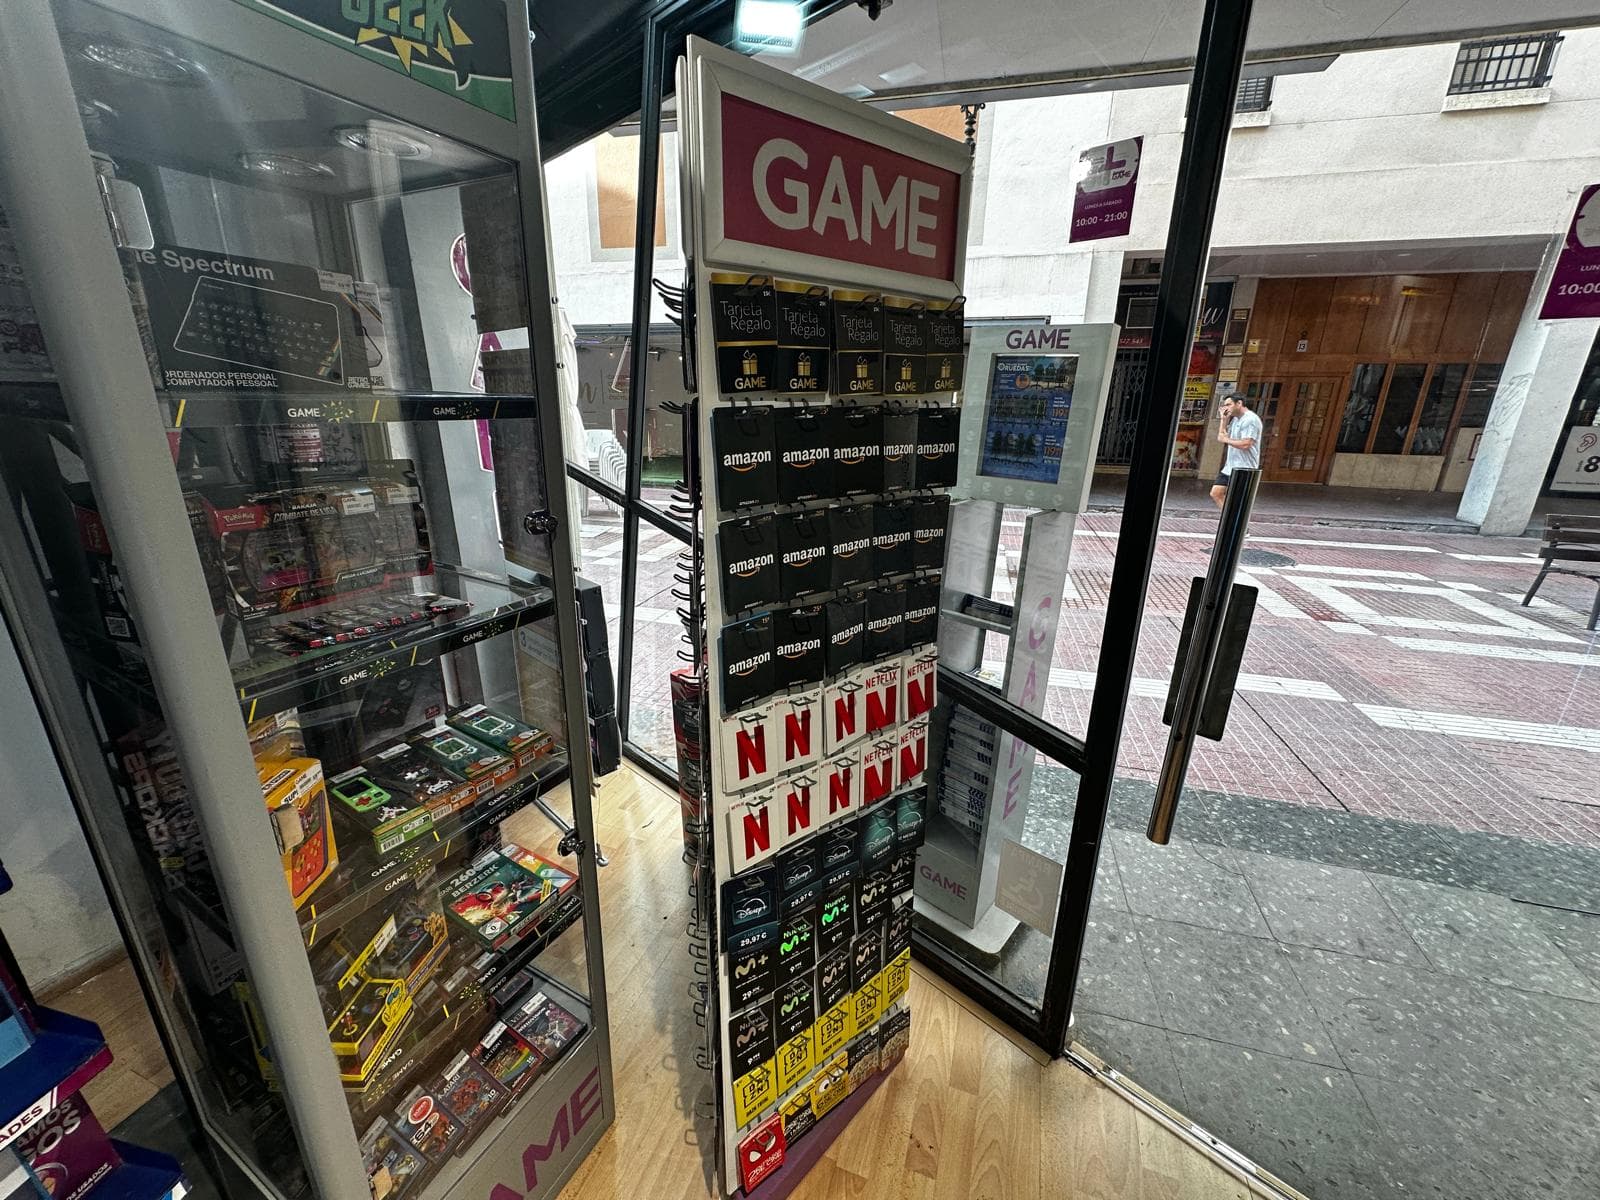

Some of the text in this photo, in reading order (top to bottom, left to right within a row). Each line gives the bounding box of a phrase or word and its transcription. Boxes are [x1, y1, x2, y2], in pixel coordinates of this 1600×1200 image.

[752, 138, 940, 259] GAME
[1076, 211, 1128, 227] 10:00 21:00
[162, 250, 275, 281] Spectrum
[720, 300, 762, 319] Tarjeta
[782, 307, 819, 328] Tarjeta
[731, 316, 771, 333] Regalo
[791, 322, 826, 339] Regalo
[840, 315, 873, 330] Tarjeta
[890, 319, 917, 334] Tarjeta
[848, 328, 879, 344] Regalo
[895, 334, 923, 348] Regalo
[1006, 329, 1071, 350] GAME
[228, 372, 277, 382] PERSONAL
[236, 379, 278, 388] PESSOAL
[735, 377, 766, 389] GAME
[789, 378, 817, 389] GAME
[849, 380, 874, 391] GAME
[934, 379, 955, 390] GAME
[894, 381, 916, 392] GAME
[287, 407, 320, 418] GAME
[433, 406, 456, 416] GAME
[783, 448, 829, 463] amazon
[834, 445, 879, 459] amazon
[917, 443, 955, 454] amazon
[724, 451, 771, 466] amazon
[833, 538, 870, 555] amazon
[873, 531, 910, 546] amazon
[783, 545, 825, 564] amazon
[729, 553, 774, 574] amazon
[905, 606, 936, 620] amazon
[868, 614, 902, 630] amazon
[463, 630, 484, 643] GAME
[831, 623, 863, 643] amazon
[777, 639, 820, 655] amazon
[729, 652, 770, 675] amazon
[907, 660, 934, 679] NETFLIX
[340, 670, 368, 686] GAME
[866, 671, 897, 690] NETFLIX
[907, 672, 934, 721] N
[835, 691, 856, 743] N
[866, 685, 896, 735] N
[785, 709, 811, 762] N
[900, 727, 926, 744] NETFLIX
[736, 725, 767, 780] N
[901, 737, 925, 786] N
[864, 757, 893, 805] N
[489, 792, 507, 807] GAME
[829, 768, 850, 815] N
[787, 786, 811, 836] N
[743, 806, 770, 860] N
[371, 861, 397, 877] GAME
[385, 873, 409, 891] GAME
[452, 863, 500, 898] BERZERK
[919, 864, 967, 900] GAME
[736, 899, 767, 918] Disney+
[824, 895, 846, 911] Nuevo
[443, 1074, 461, 1093] ATARI
